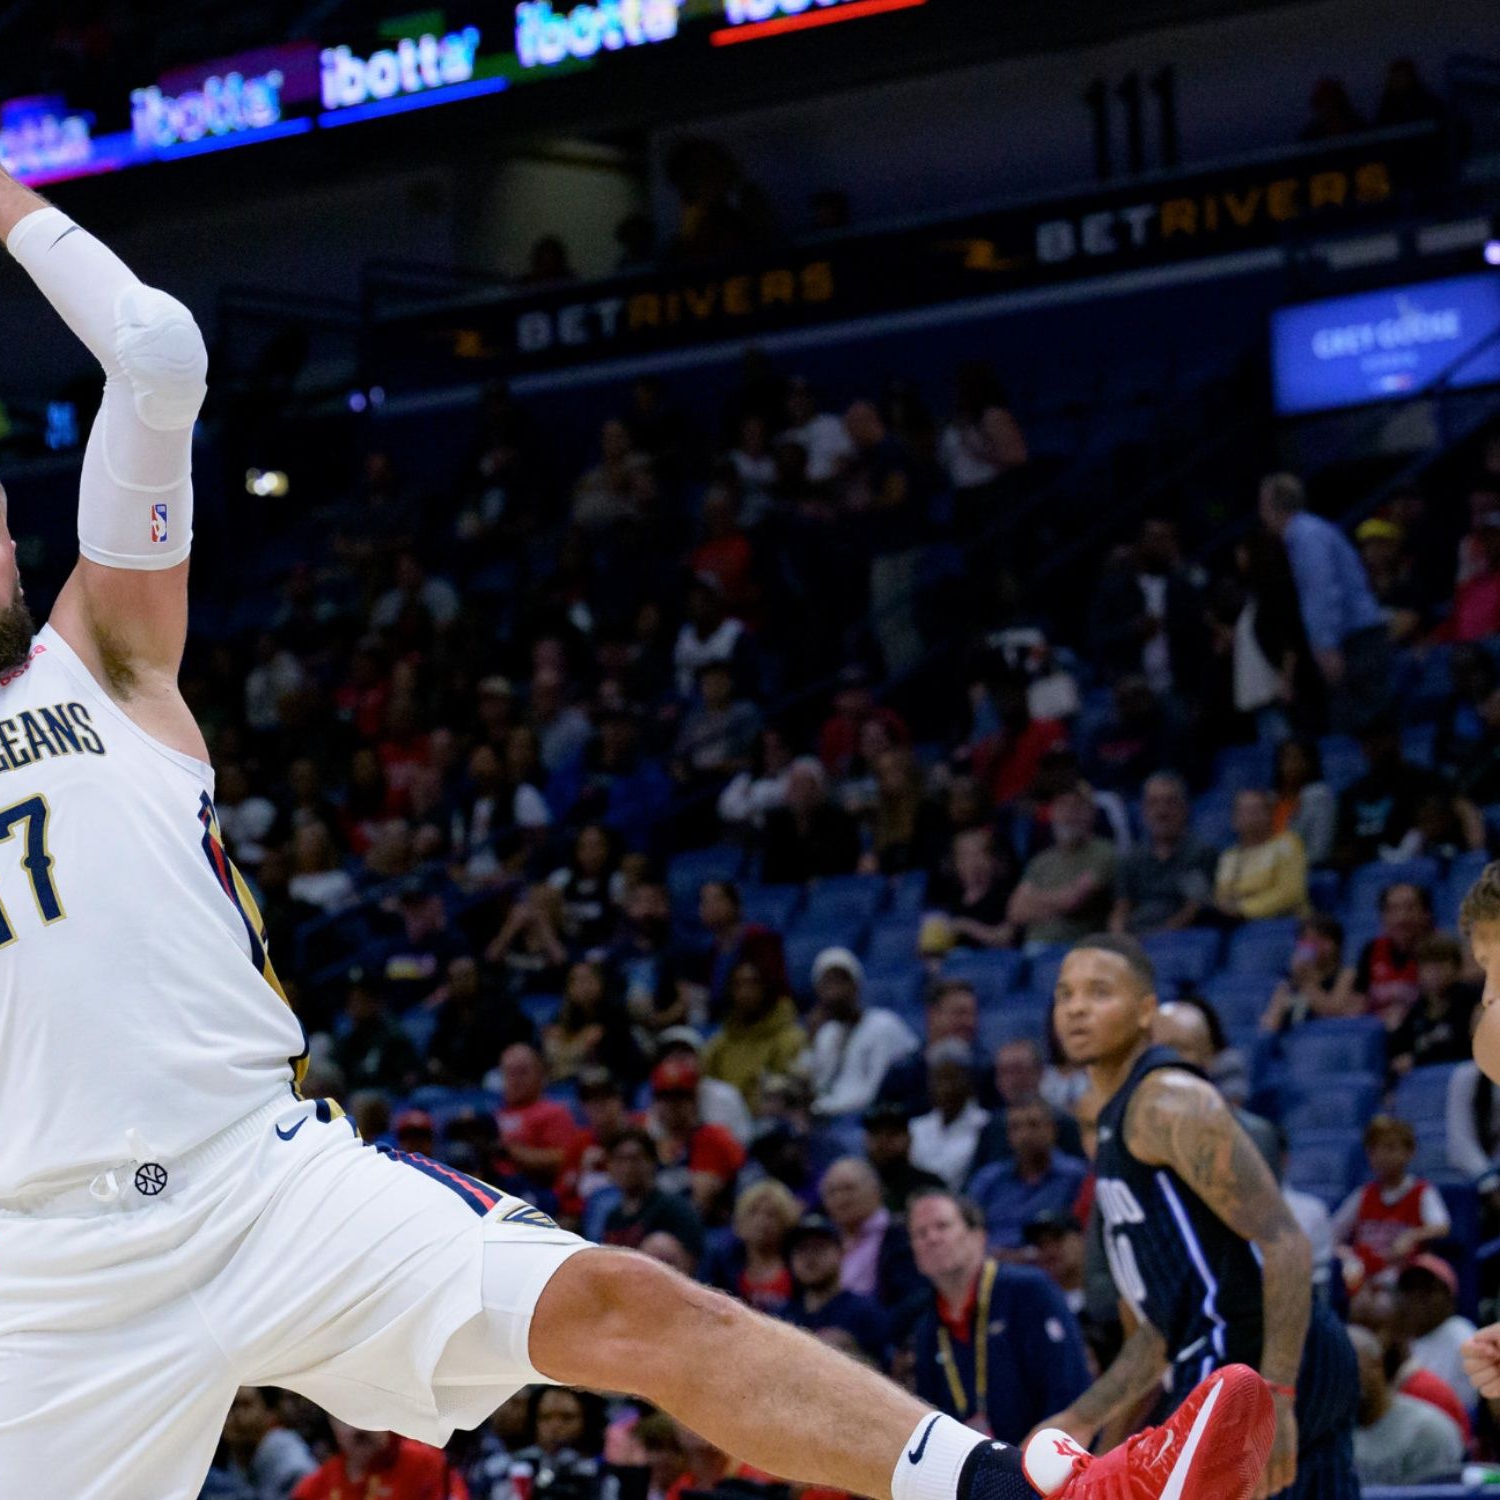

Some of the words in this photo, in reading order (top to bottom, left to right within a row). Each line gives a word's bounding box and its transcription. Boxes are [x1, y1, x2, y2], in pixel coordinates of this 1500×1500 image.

[320, 28, 478, 108] ibotta
[1084, 65, 1176, 178] 111
[1036, 161, 1390, 263] BETRIVERS
[515, 260, 834, 353] BETRIVERS
